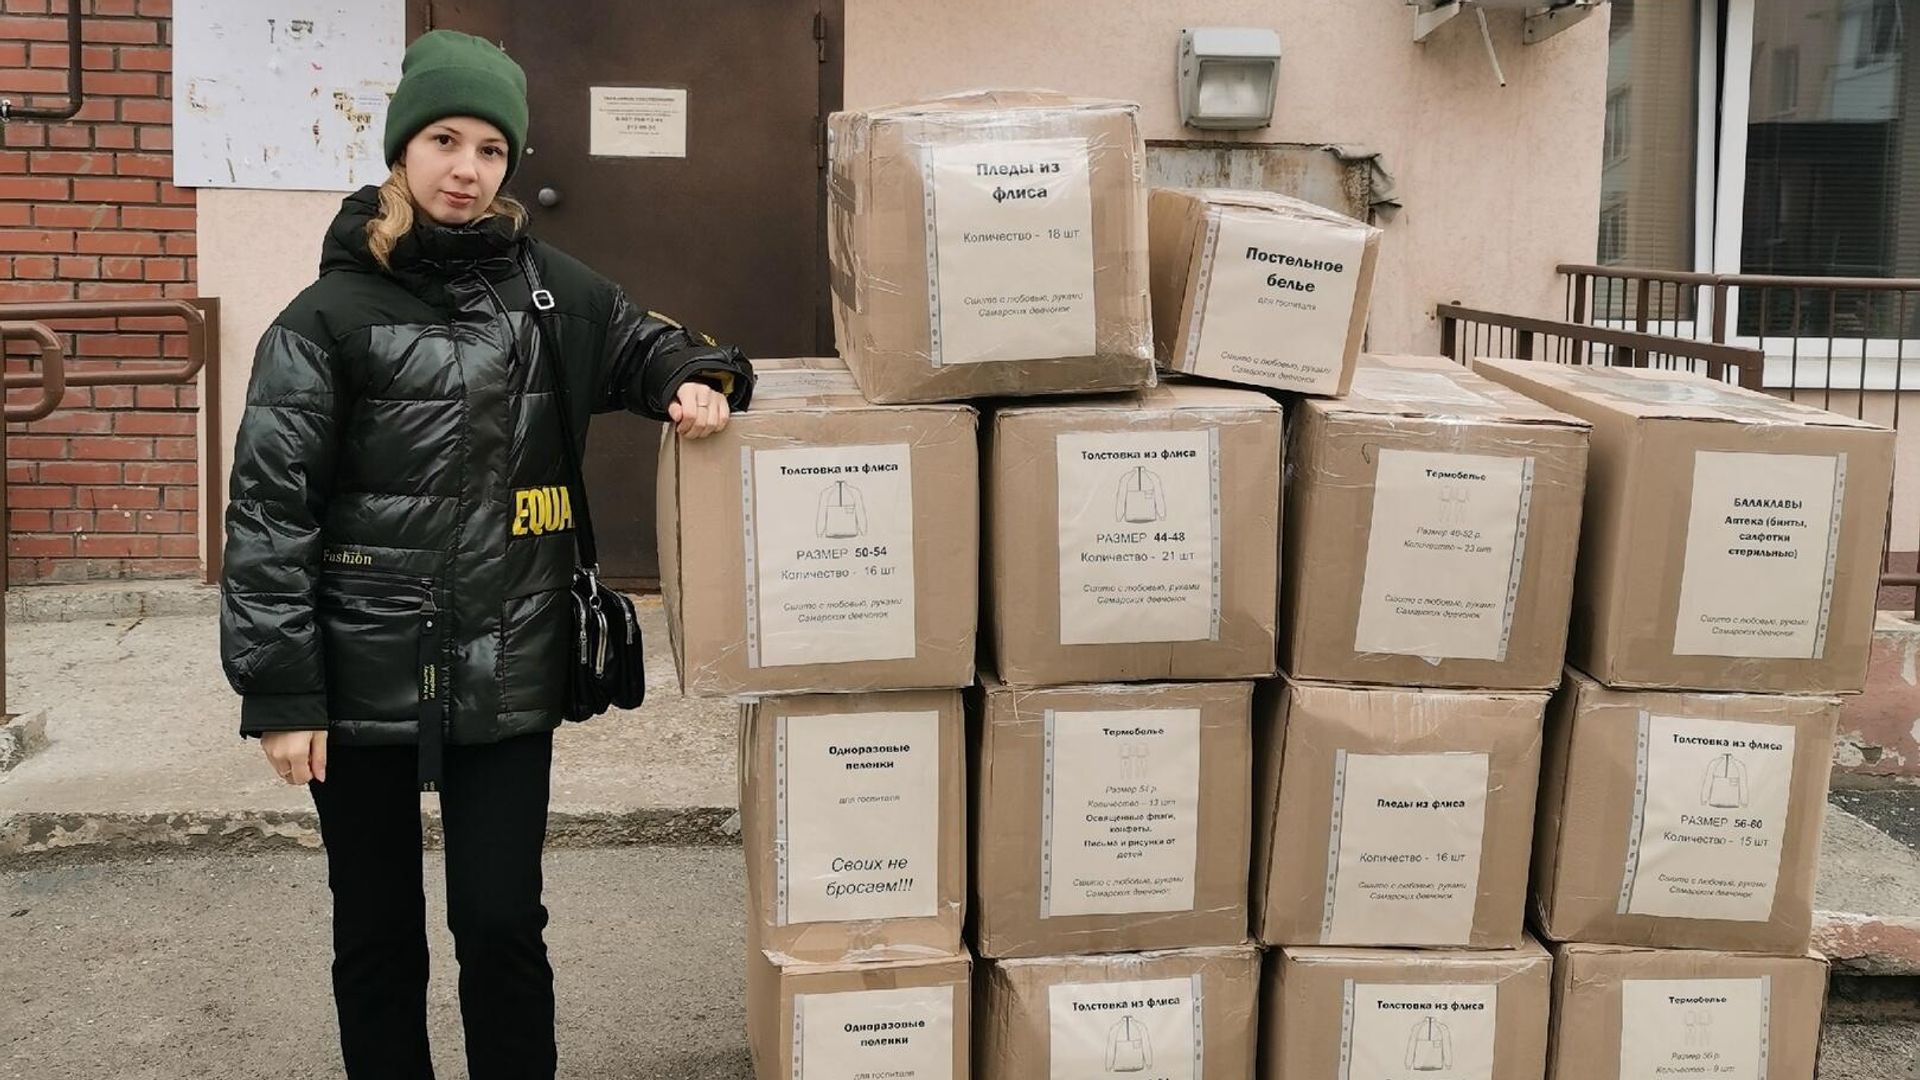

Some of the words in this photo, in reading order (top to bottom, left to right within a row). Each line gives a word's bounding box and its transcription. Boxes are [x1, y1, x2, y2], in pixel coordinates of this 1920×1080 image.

[976, 162, 1034, 177] Пледы
[1039, 162, 1060, 174] из
[992, 186, 1048, 203] флиса
[963, 232, 1032, 244] Количество
[1048, 228, 1061, 239] 18
[1064, 229, 1080, 239] шт
[1246, 247, 1344, 273] Постельное
[1267, 273, 1316, 293] белье
[1081, 451, 1142, 460] Толстовка
[1144, 450, 1158, 459] из
[1161, 449, 1196, 460] флиса
[780, 465, 842, 476] Толстовка
[845, 465, 859, 473] из
[862, 463, 899, 474] флиса
[1425, 469, 1487, 482] Термобелье
[1734, 498, 1802, 509] БАЛАКЛАВЫ
[1725, 516, 1763, 527] Аптека
[1766, 516, 1807, 529] (бинты,
[1097, 533, 1148, 544] РАЗМЕР
[1154, 532, 1186, 542] 44-48
[1739, 531, 1790, 543] салфетки
[323, 549, 372, 565] Fashion
[797, 549, 849, 560] РАЗМЕР
[855, 547, 887, 558] 50-54
[1081, 552, 1148, 562] Количество
[1162, 551, 1175, 561] 21
[1179, 552, 1195, 561] шт
[1728, 548, 1798, 559] стерильные)
[781, 569, 850, 580] Количество
[864, 566, 877, 576] 16
[880, 566, 896, 576] шт
[1103, 728, 1165, 737] Термобелье
[1673, 734, 1730, 747] Толстовка
[1732, 740, 1746, 748] из
[1749, 740, 1783, 751] флиса
[829, 744, 910, 756] Одноразовые
[846, 761, 894, 771] пеленки
[1377, 799, 1413, 809] Пледы
[1415, 800, 1429, 809] из
[1432, 799, 1465, 810] флиса
[1680, 815, 1728, 828] РАЗМЕР
[1733, 819, 1763, 829] 56-60
[1663, 831, 1726, 846] Количество
[1740, 836, 1752, 847] 15
[1754, 839, 1769, 847] шт
[1360, 853, 1423, 863] Количество
[1436, 853, 1448, 862] 16
[1451, 854, 1466, 862] шт
[832, 857, 883, 873] Своих
[888, 858, 908, 870] не
[826, 878, 914, 899] бросаем!!!
[1072, 1000, 1129, 1012] Толстовка
[1131, 1000, 1144, 1008] из
[1147, 997, 1180, 1009] флиса
[1377, 1000, 1432, 1010] Толстовка
[1435, 1002, 1448, 1011] из
[1450, 1001, 1484, 1012] флиса
[1669, 996, 1727, 1005] Термобелье
[844, 1020, 925, 1033] Одноразовые
[860, 1037, 909, 1047] пеленки
